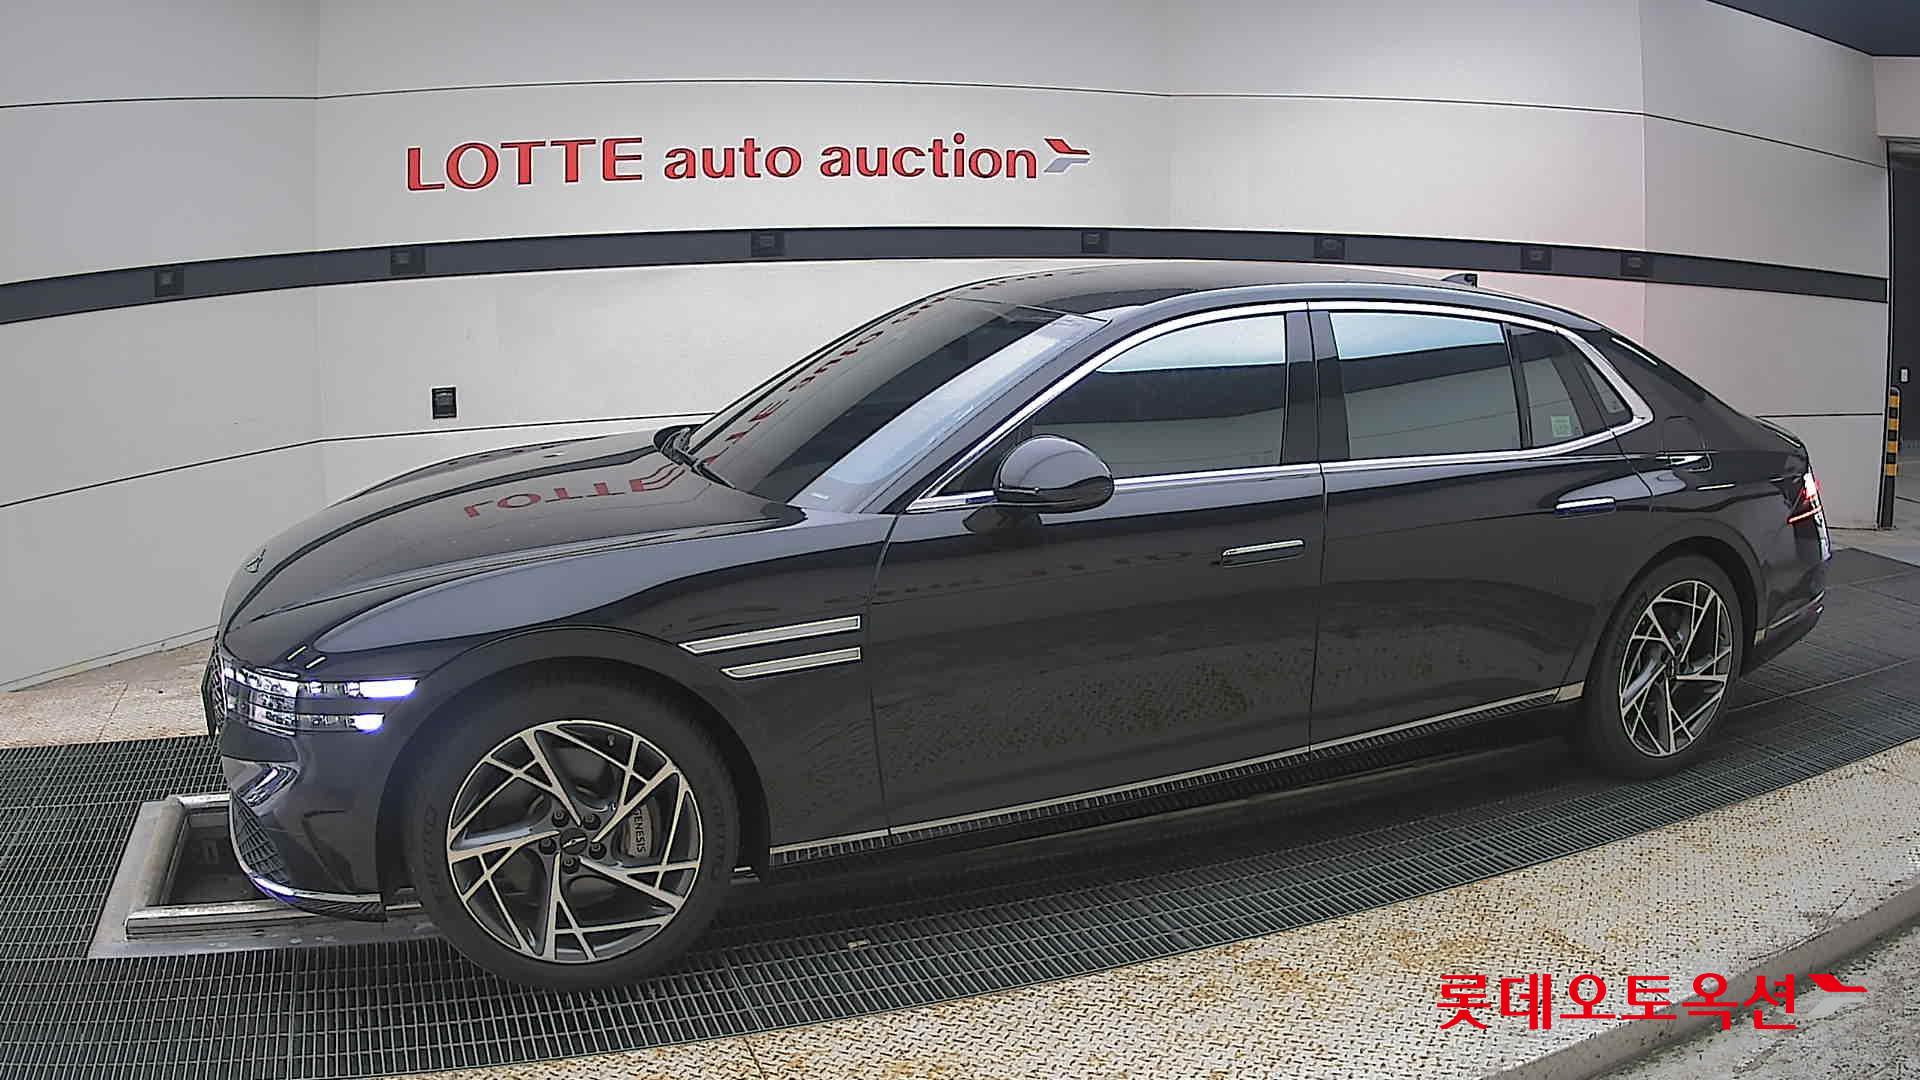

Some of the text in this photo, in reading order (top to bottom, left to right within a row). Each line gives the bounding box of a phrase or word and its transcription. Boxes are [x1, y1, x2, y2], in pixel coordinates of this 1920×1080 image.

[407, 132, 1038, 192] LOTTE auto auction
